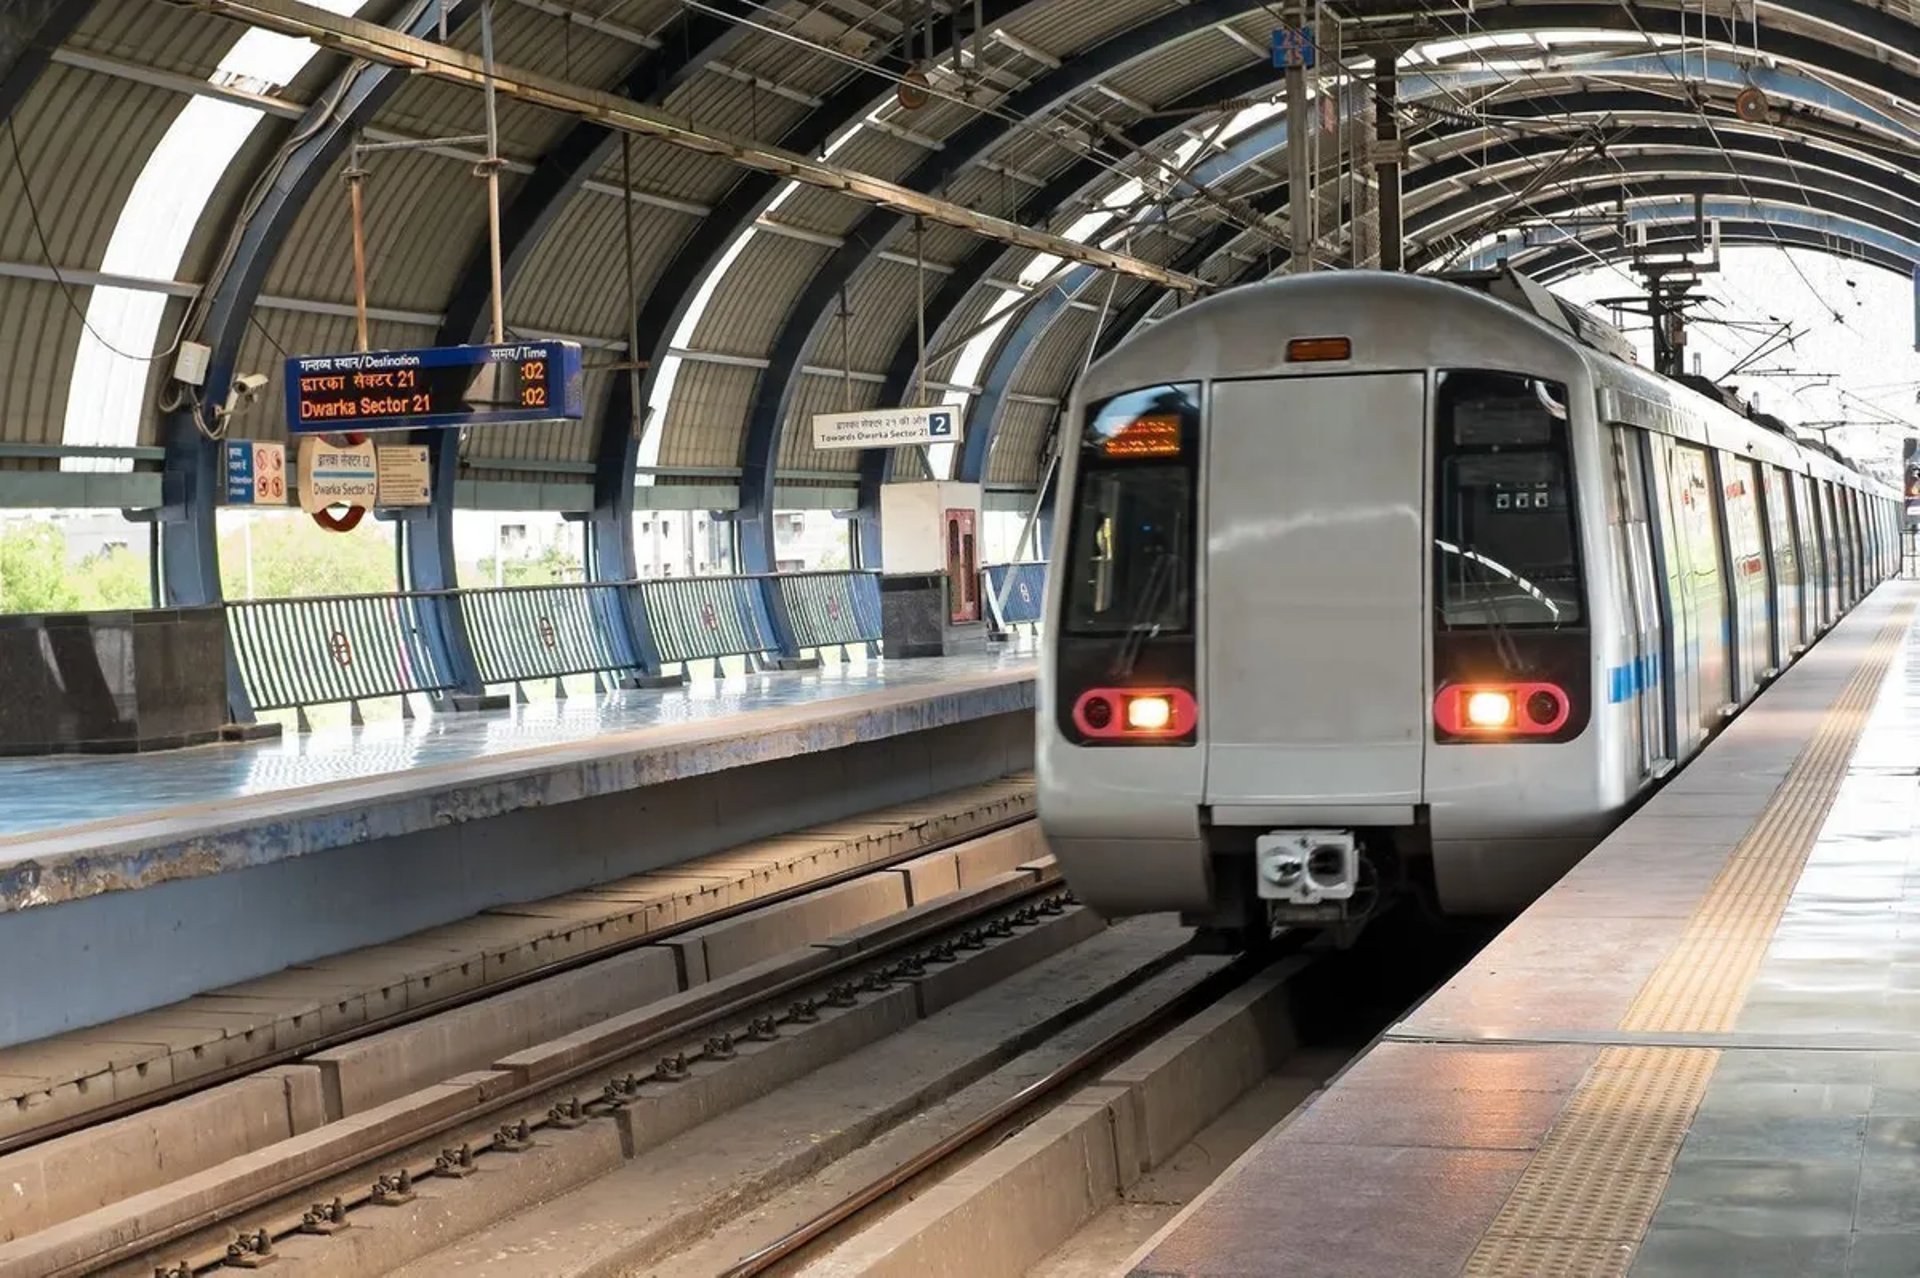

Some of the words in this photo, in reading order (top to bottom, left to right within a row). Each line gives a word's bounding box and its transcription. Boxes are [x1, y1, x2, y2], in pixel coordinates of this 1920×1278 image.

[490, 346, 547, 360] समय/Time
[521, 362, 544, 379] :02
[301, 376, 345, 391] द्वारका
[397, 370, 414, 387] 21
[522, 387, 545, 405] :02
[301, 399, 356, 418] Dwarka
[361, 397, 408, 414] Sector
[412, 394, 430, 412] 21
[935, 416, 946, 432] 2
[821, 432, 856, 442] Towards
[857, 431, 888, 441] Dwarka
[890, 430, 916, 439] Sector
[314, 482, 341, 495] Dwarka
[342, 482, 365, 495] Sector
[367, 482, 375, 495] 12
